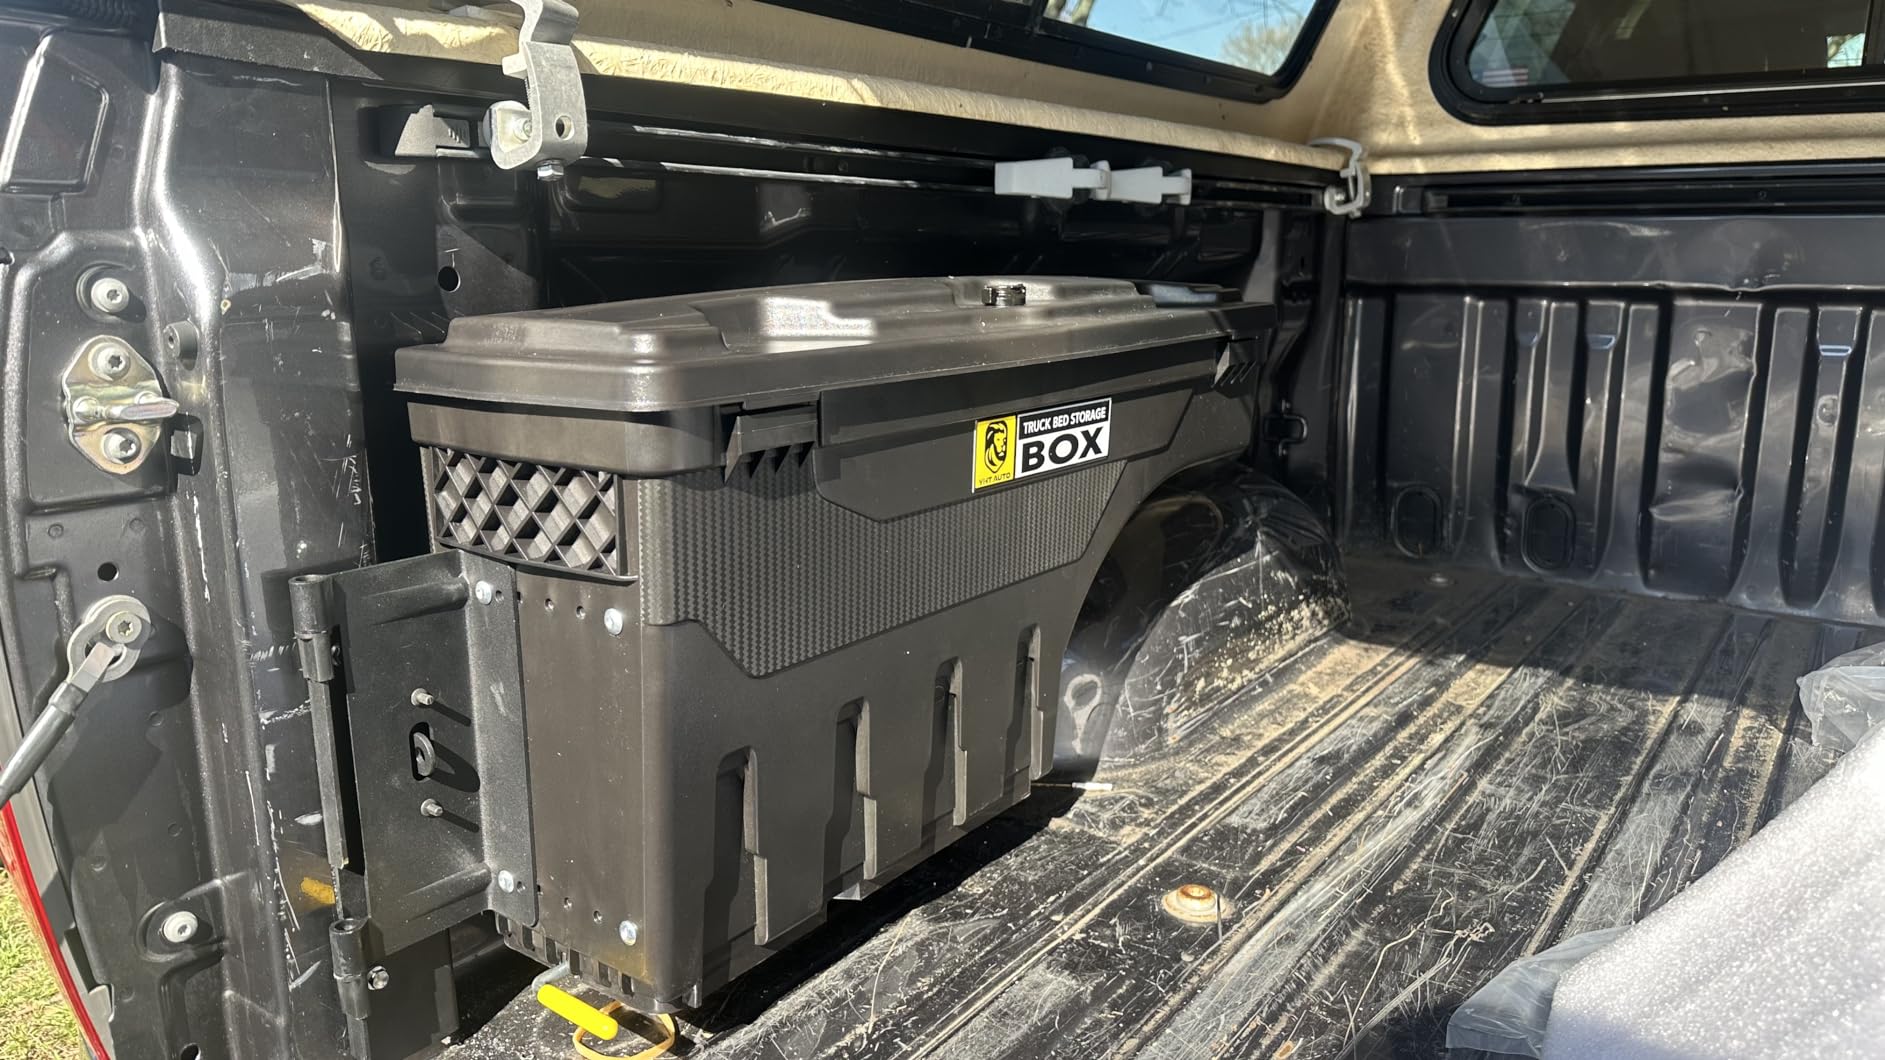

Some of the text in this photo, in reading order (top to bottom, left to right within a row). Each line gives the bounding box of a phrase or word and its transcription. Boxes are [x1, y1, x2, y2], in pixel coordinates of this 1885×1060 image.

[1023, 406, 1106, 434] TRUCK BED STORAGE
[1021, 426, 1103, 473] BOX
[994, 472, 1011, 481] AUTO
